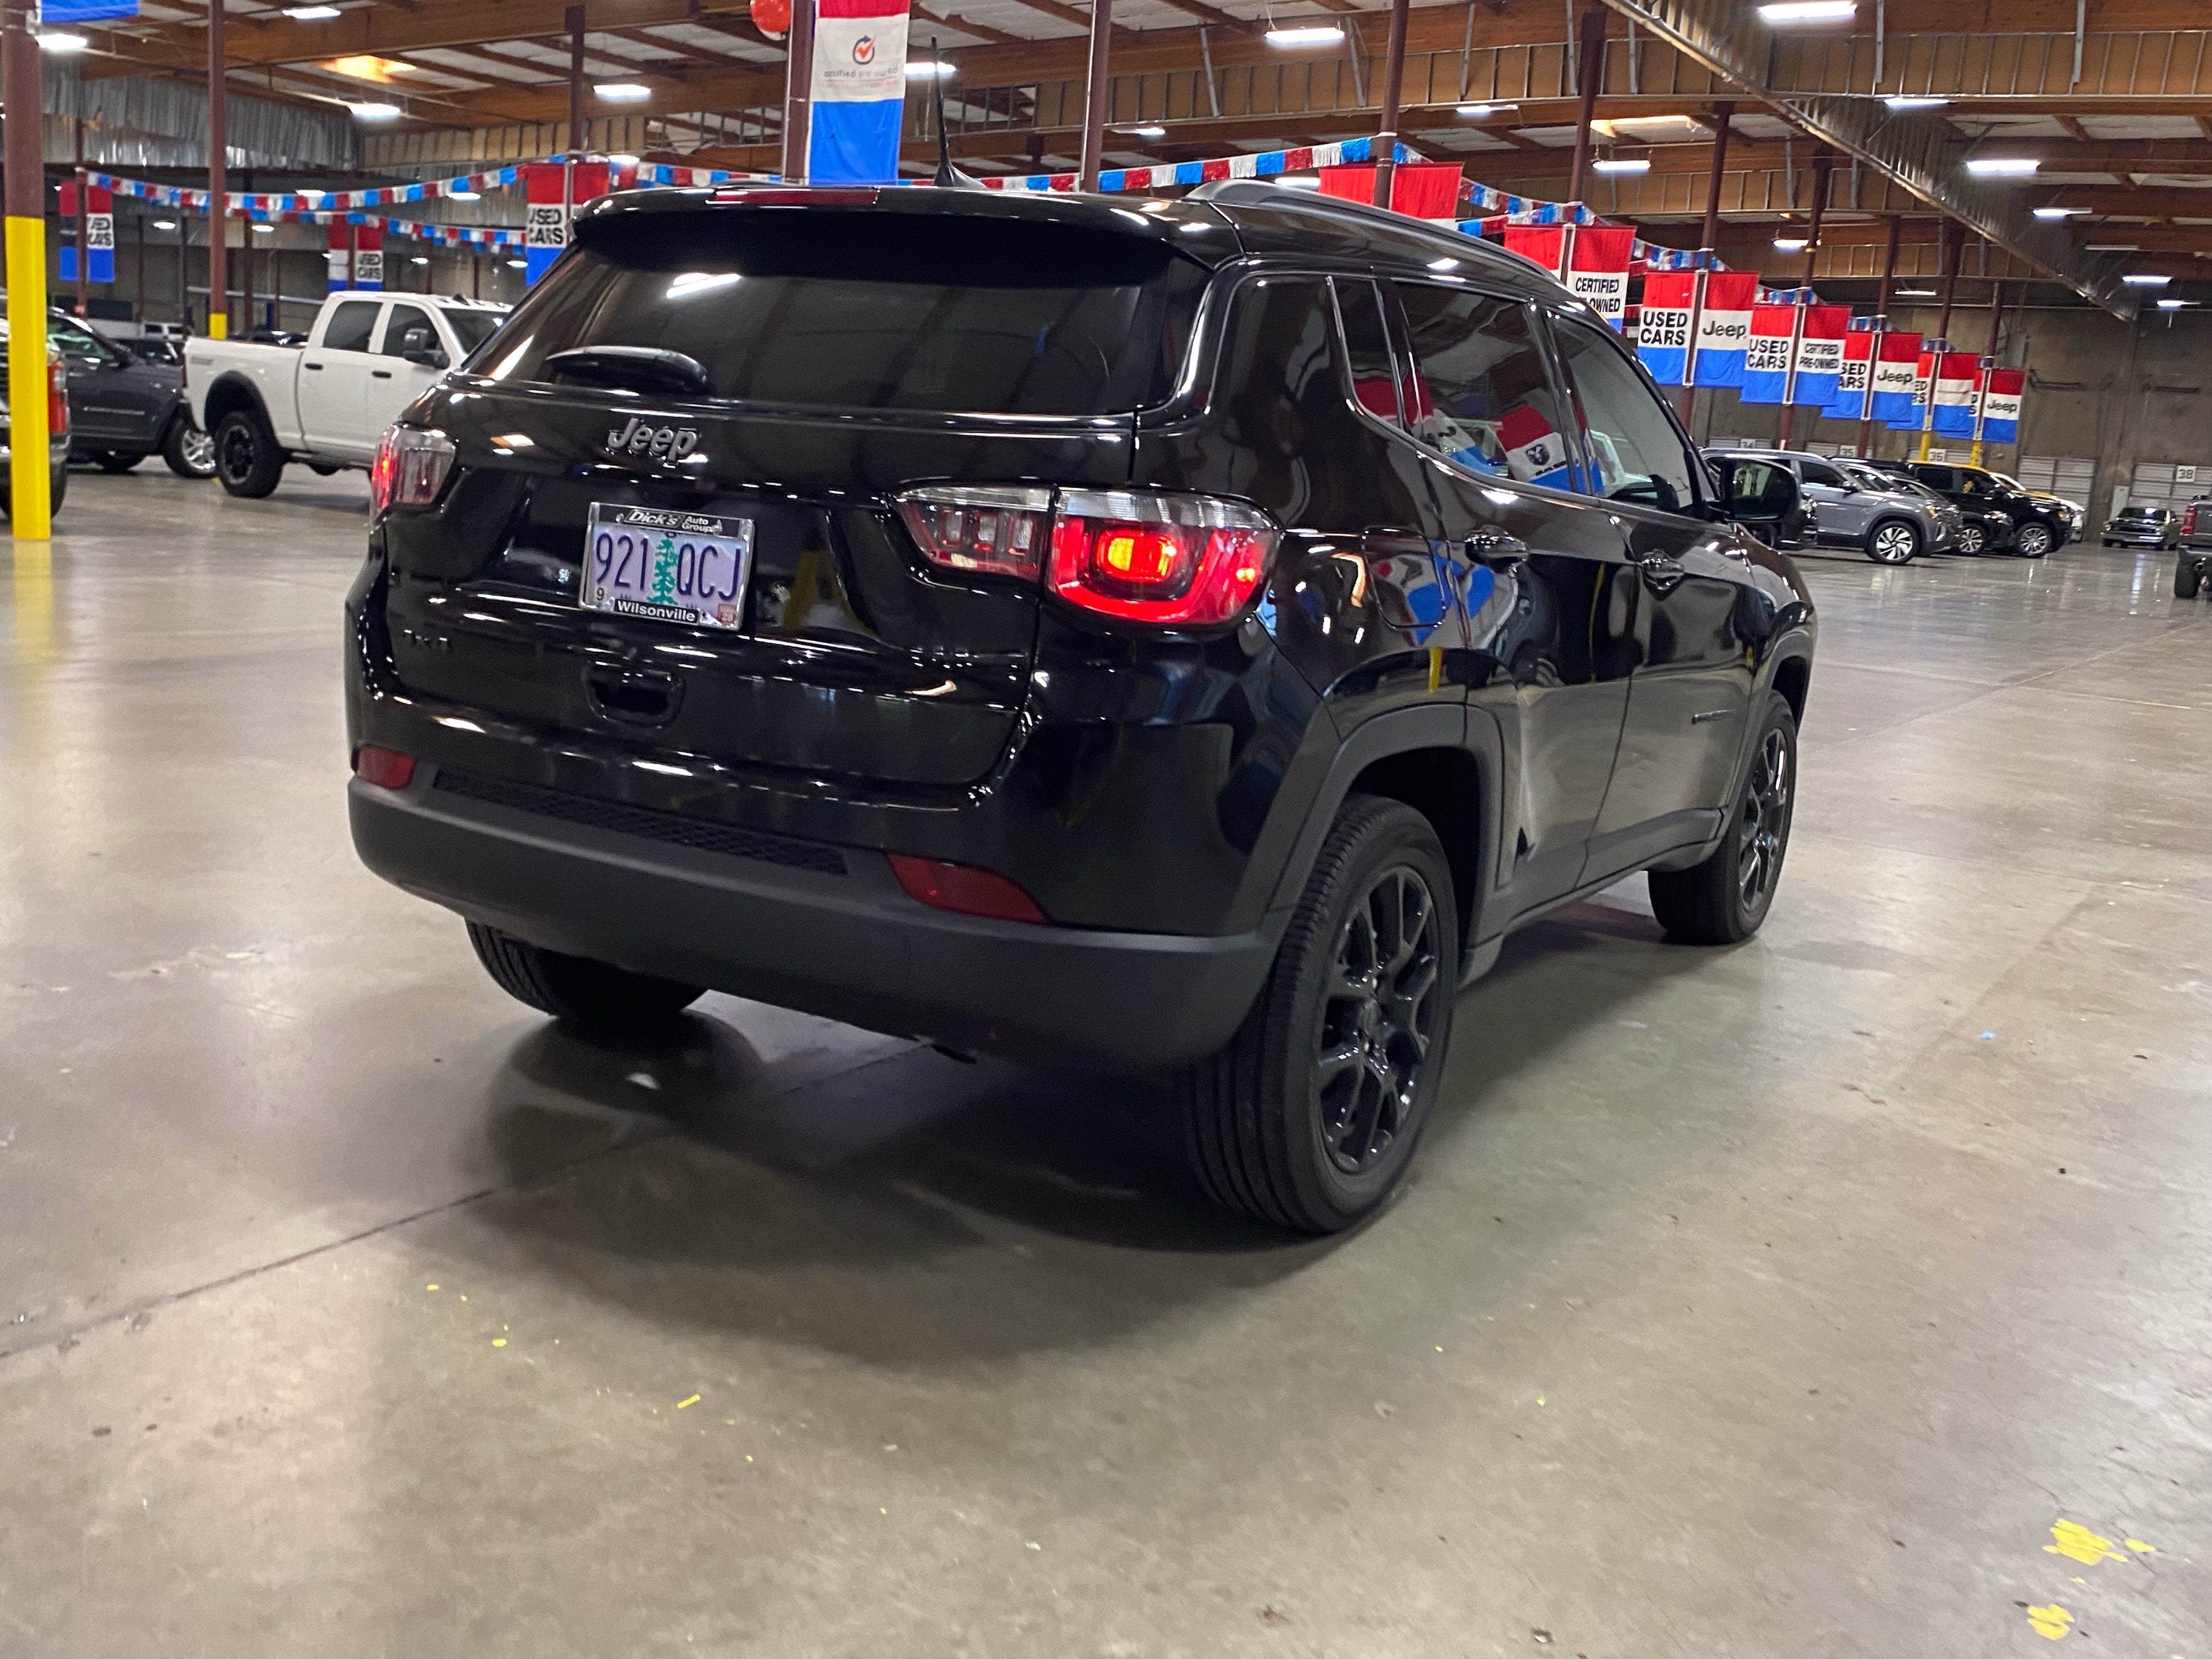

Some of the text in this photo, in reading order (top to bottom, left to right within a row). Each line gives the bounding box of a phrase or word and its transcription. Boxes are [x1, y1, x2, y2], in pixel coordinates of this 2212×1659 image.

[1576, 277, 1620, 293] CERTIFIED
[1643, 311, 1688, 328] USED
[1640, 328, 1686, 346] CARS
[1703, 320, 1747, 340] Jeep
[1750, 339, 1788, 353] USED
[1747, 354, 1787, 369] CARS
[1841, 362, 1867, 375] SED
[1839, 376, 1865, 388] ARS
[1877, 370, 1913, 385] Jeep
[1987, 400, 2018, 413] Jeep
[607, 417, 698, 466] Jeep
[2178, 469, 2194, 479] 38
[629, 509, 678, 526] Dick's
[685, 516, 709, 525] Auto
[681, 522, 713, 534] Group
[596, 532, 741, 601] 921 QCJ
[617, 600, 696, 622] Wilsonville
